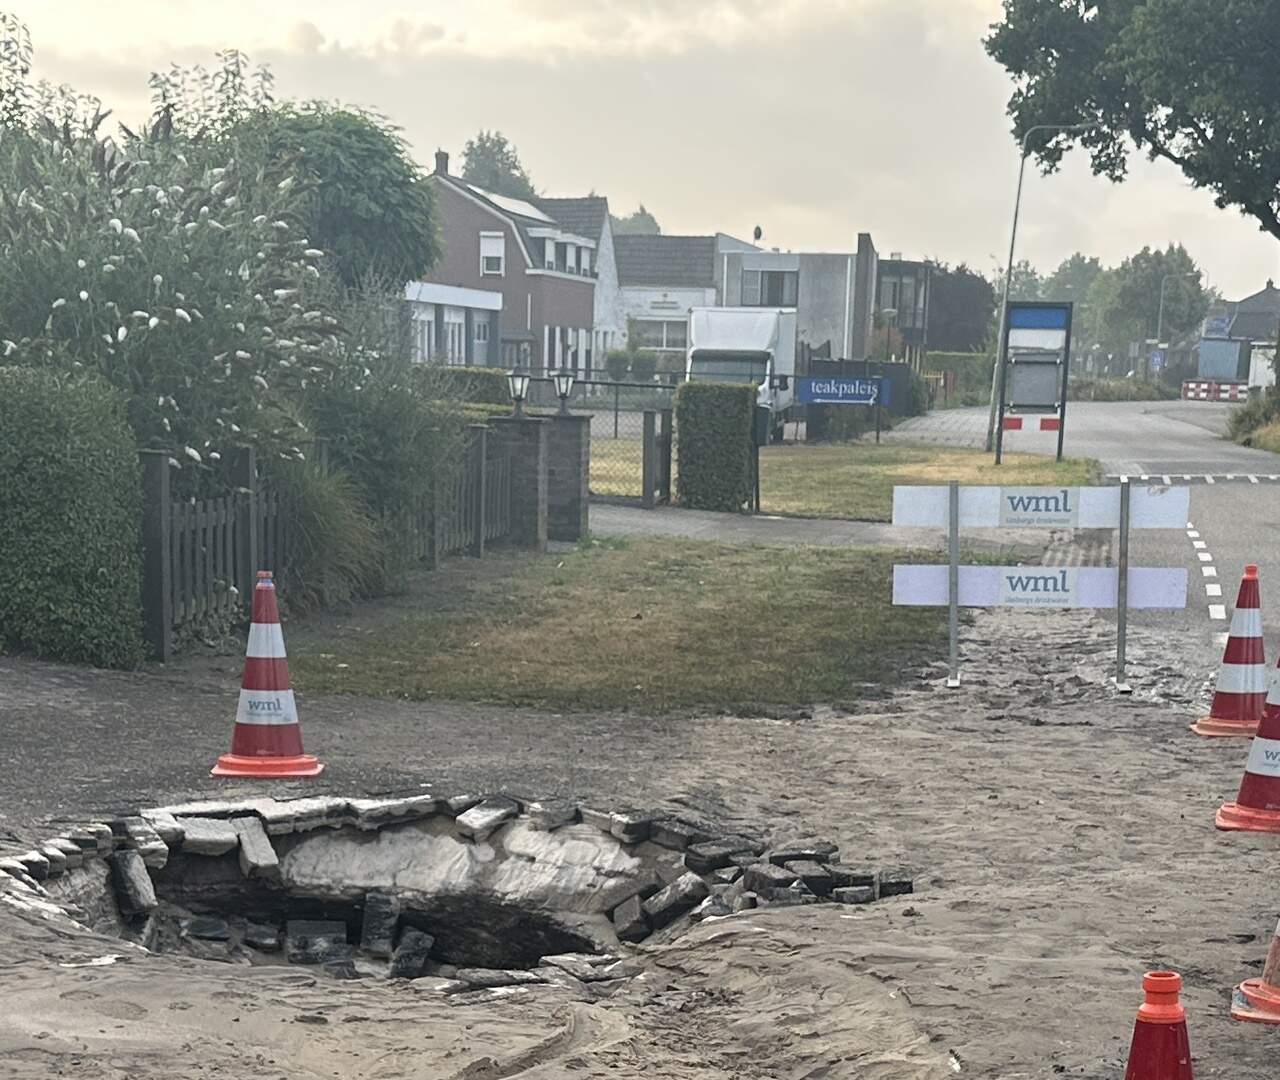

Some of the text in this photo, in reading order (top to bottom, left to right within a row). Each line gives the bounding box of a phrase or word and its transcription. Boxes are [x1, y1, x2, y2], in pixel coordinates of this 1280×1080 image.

[811, 380, 878, 397] teakpaleis
[1007, 489, 1072, 512] wml
[1006, 570, 1070, 592] wml
[248, 699, 282, 711] wml
